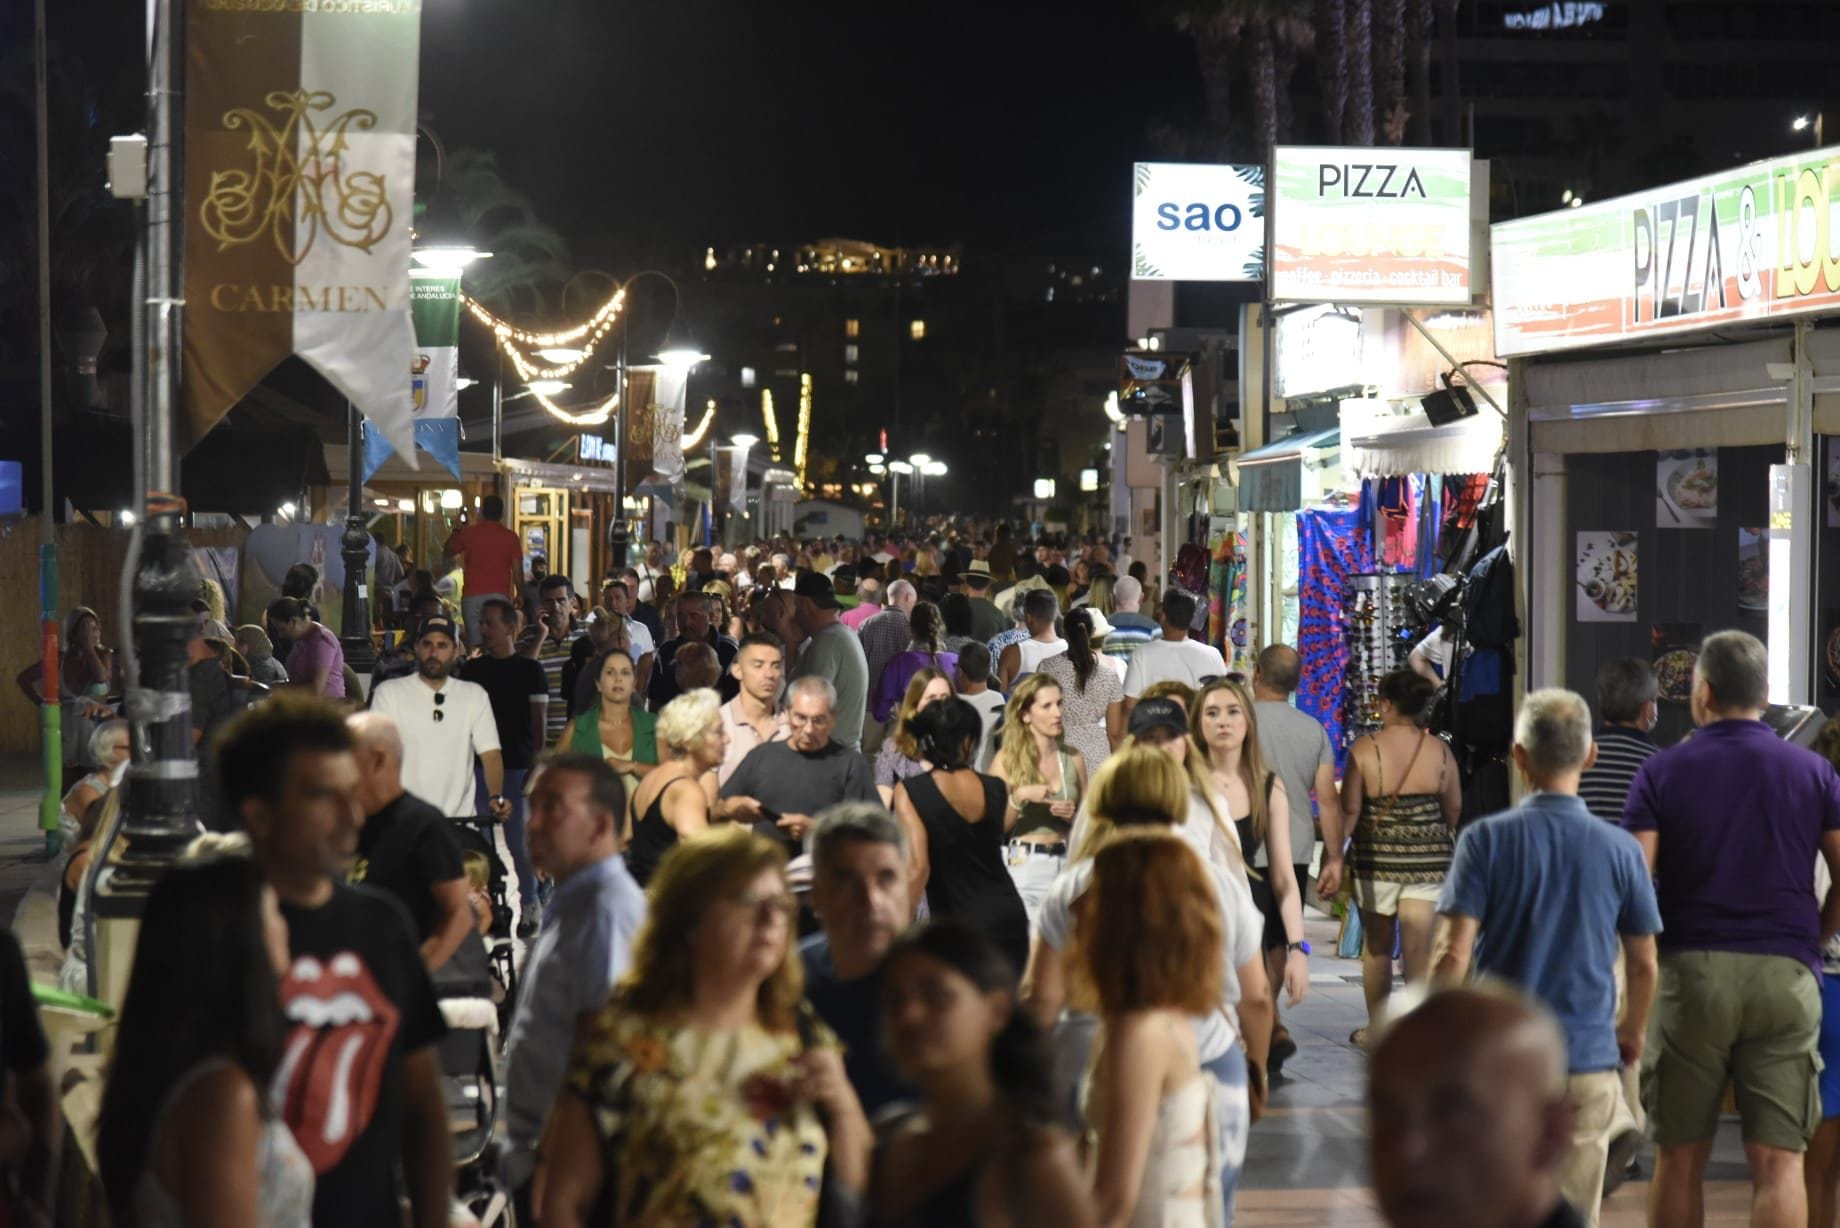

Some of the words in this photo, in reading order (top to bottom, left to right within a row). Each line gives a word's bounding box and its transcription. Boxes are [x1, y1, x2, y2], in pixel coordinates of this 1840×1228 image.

[1319, 164, 1426, 198] PIZZA
[1157, 202, 1242, 232] sao
[1633, 190, 1726, 323] PIZZA
[1737, 185, 1762, 299] &
[1390, 269, 1438, 286] cocktail
[1441, 270, 1463, 287] bar
[209, 283, 389, 313] CARMEN
